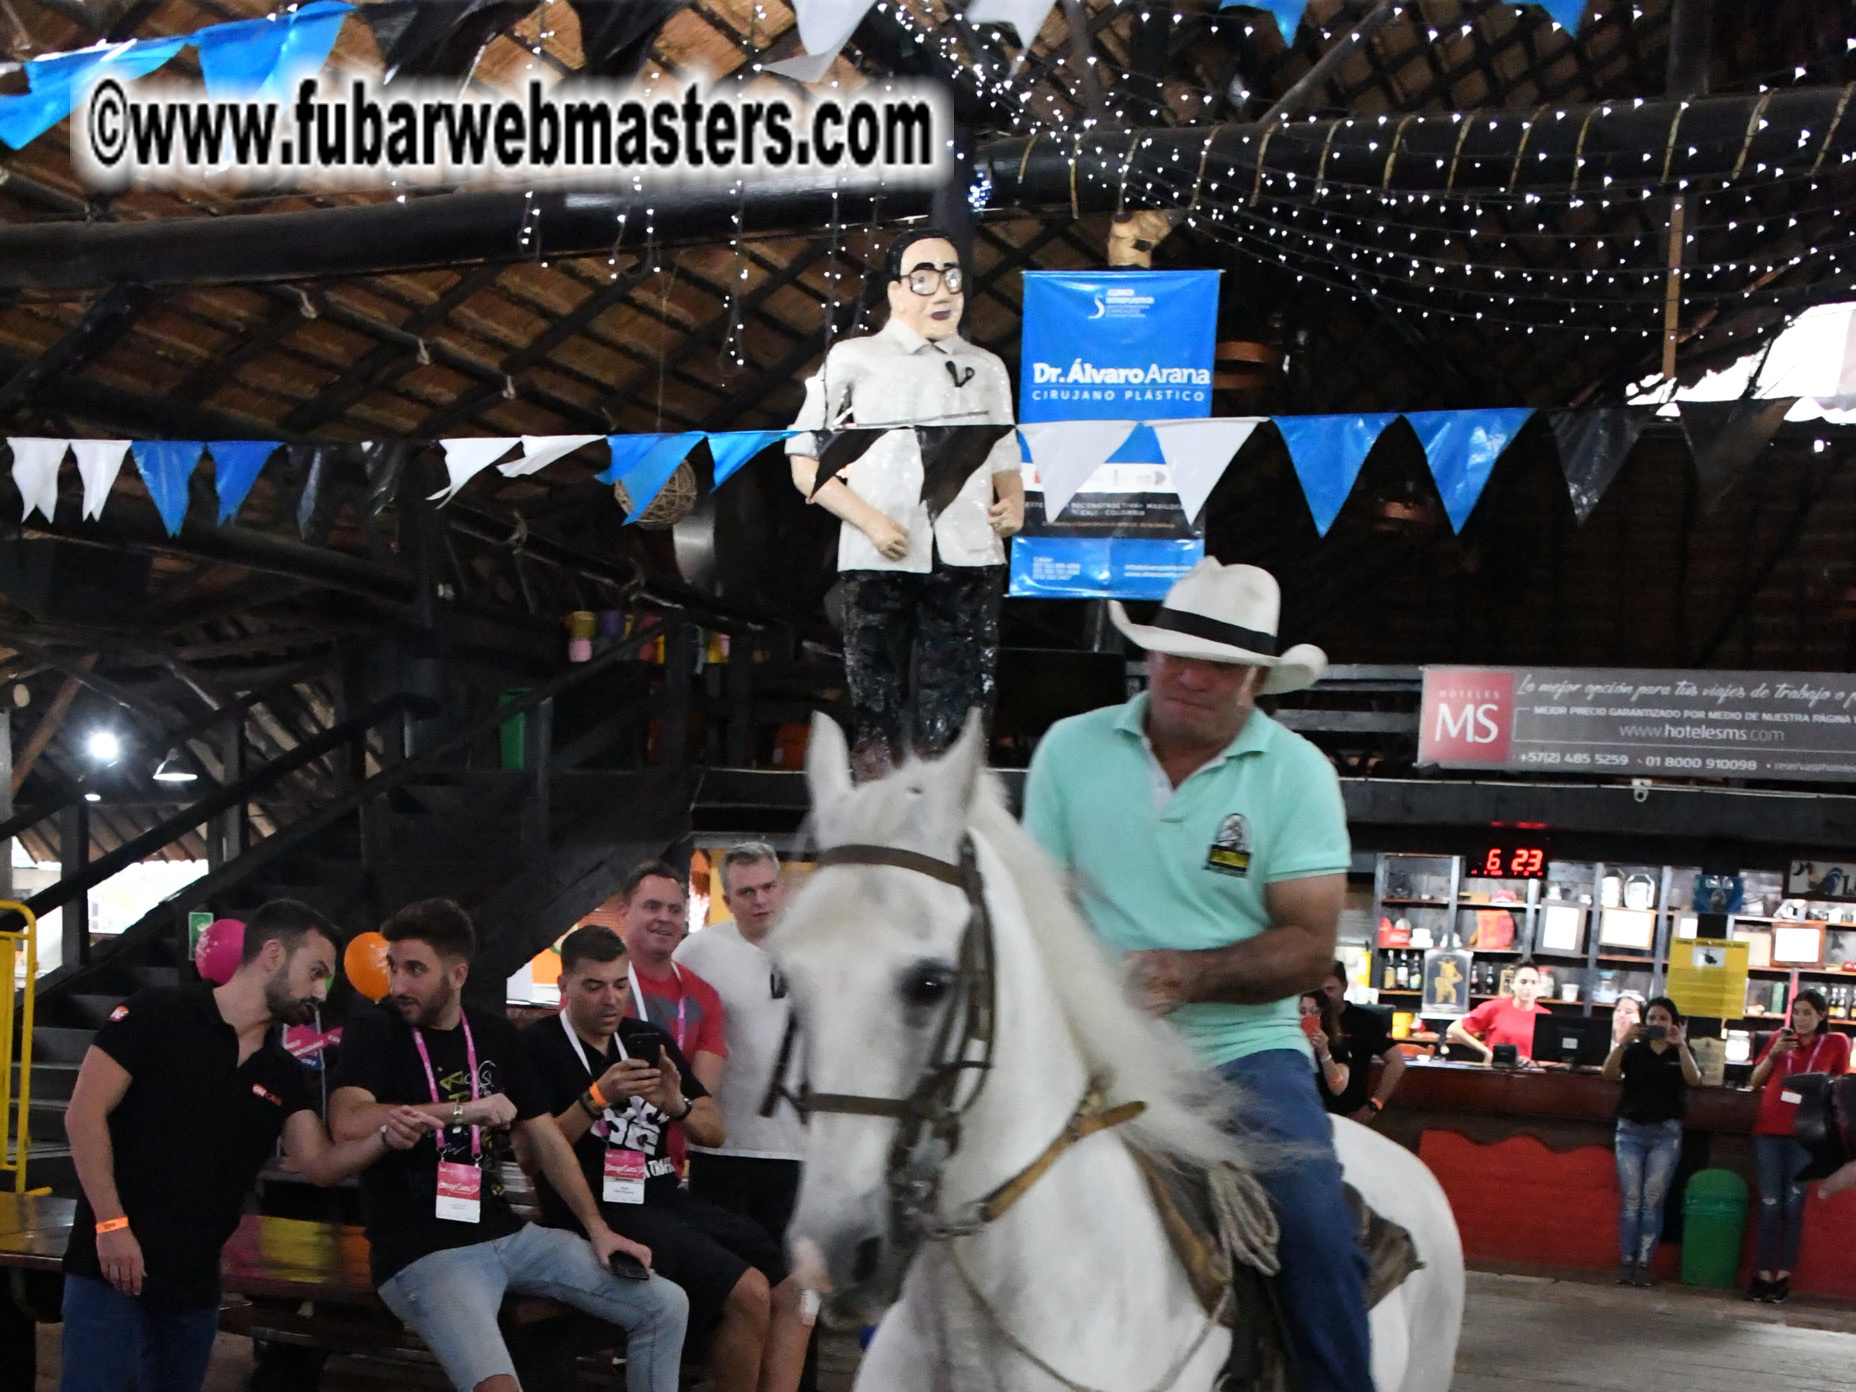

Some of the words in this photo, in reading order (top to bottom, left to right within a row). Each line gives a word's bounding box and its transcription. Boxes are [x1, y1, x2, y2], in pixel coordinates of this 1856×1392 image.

[1032, 390, 1116, 401] CIRUJANO
[1124, 389, 1205, 402] PLÁSTICO
[1537, 680, 1582, 701] mejor
[1584, 681, 1634, 701] opción
[1629, 684, 1671, 702] para
[1673, 680, 1698, 697] tus
[1702, 684, 1746, 705] viajes
[1750, 682, 1770, 699] de
[1774, 683, 1832, 708] trabajo
[1533, 706, 1567, 715] MEJOR
[1569, 707, 1607, 716] PRECIO
[1608, 708, 1681, 718] GARANTIZADO
[1683, 710, 1706, 719] POR
[1708, 711, 1743, 720] MEDIO
[1744, 712, 1760, 721] DE
[1761, 712, 1810, 722] NUESTRA
[1434, 703, 1499, 744] MS
[1619, 723, 1785, 742] www.hotelesms.com
[1564, 754, 1591, 764] 485
[1594, 754, 1629, 766] 5259
[1645, 756, 1661, 767] 01
[1664, 757, 1702, 769] 8000
[1706, 758, 1758, 771] 910098
[1486, 848, 1503, 872] 6
[1510, 849, 1544, 872] 23
